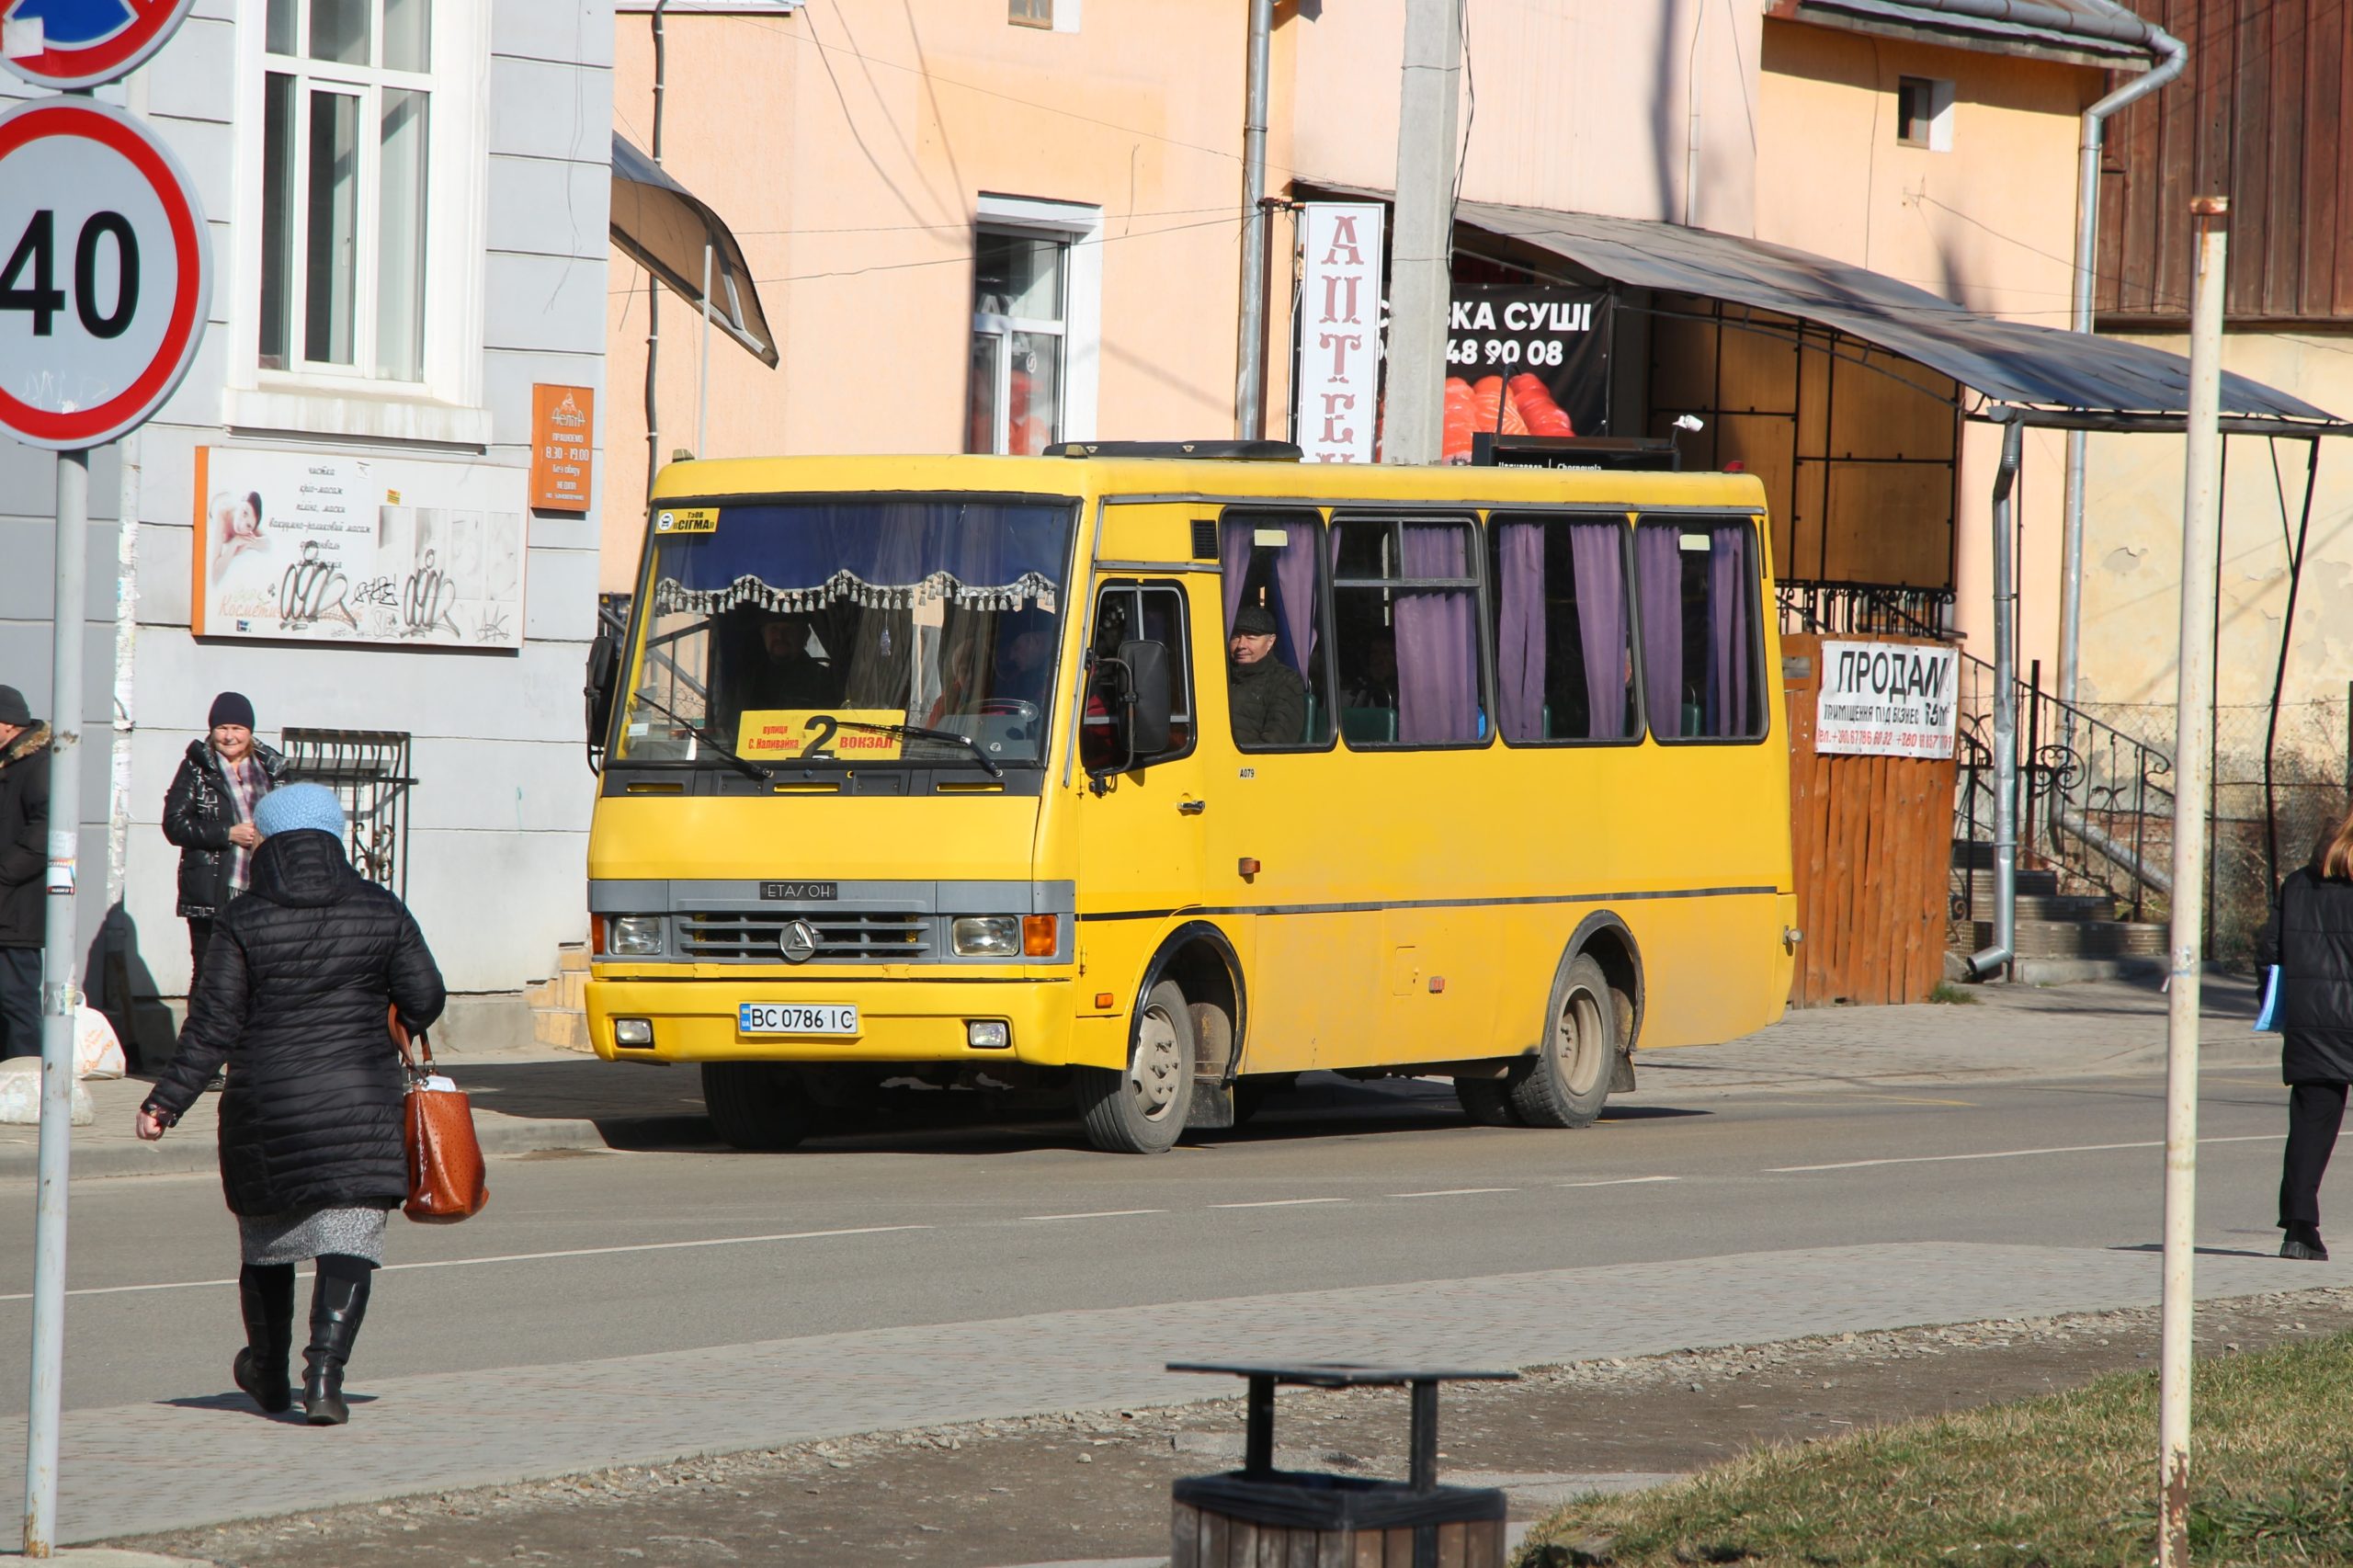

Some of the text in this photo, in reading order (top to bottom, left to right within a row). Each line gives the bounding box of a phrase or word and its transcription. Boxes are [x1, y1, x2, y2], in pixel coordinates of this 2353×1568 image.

[0, 210, 140, 339] 40
[1504, 301, 1591, 331] СУШІ
[1484, 339, 1520, 365] 90
[1527, 340, 1563, 366] 08
[545, 446, 563, 459] 8.30
[1837, 651, 1949, 705] ПРОДАМ
[1824, 704, 1873, 723] ПРИМІЩЕННЯ
[1875, 706, 1891, 724] ПІД
[1893, 707, 1919, 725] БІЗНЕС
[763, 725, 789, 735] вулиця
[801, 715, 838, 758] 2
[839, 736, 893, 748] ВОКЗАЛ
[756, 737, 799, 749] Наливайка
